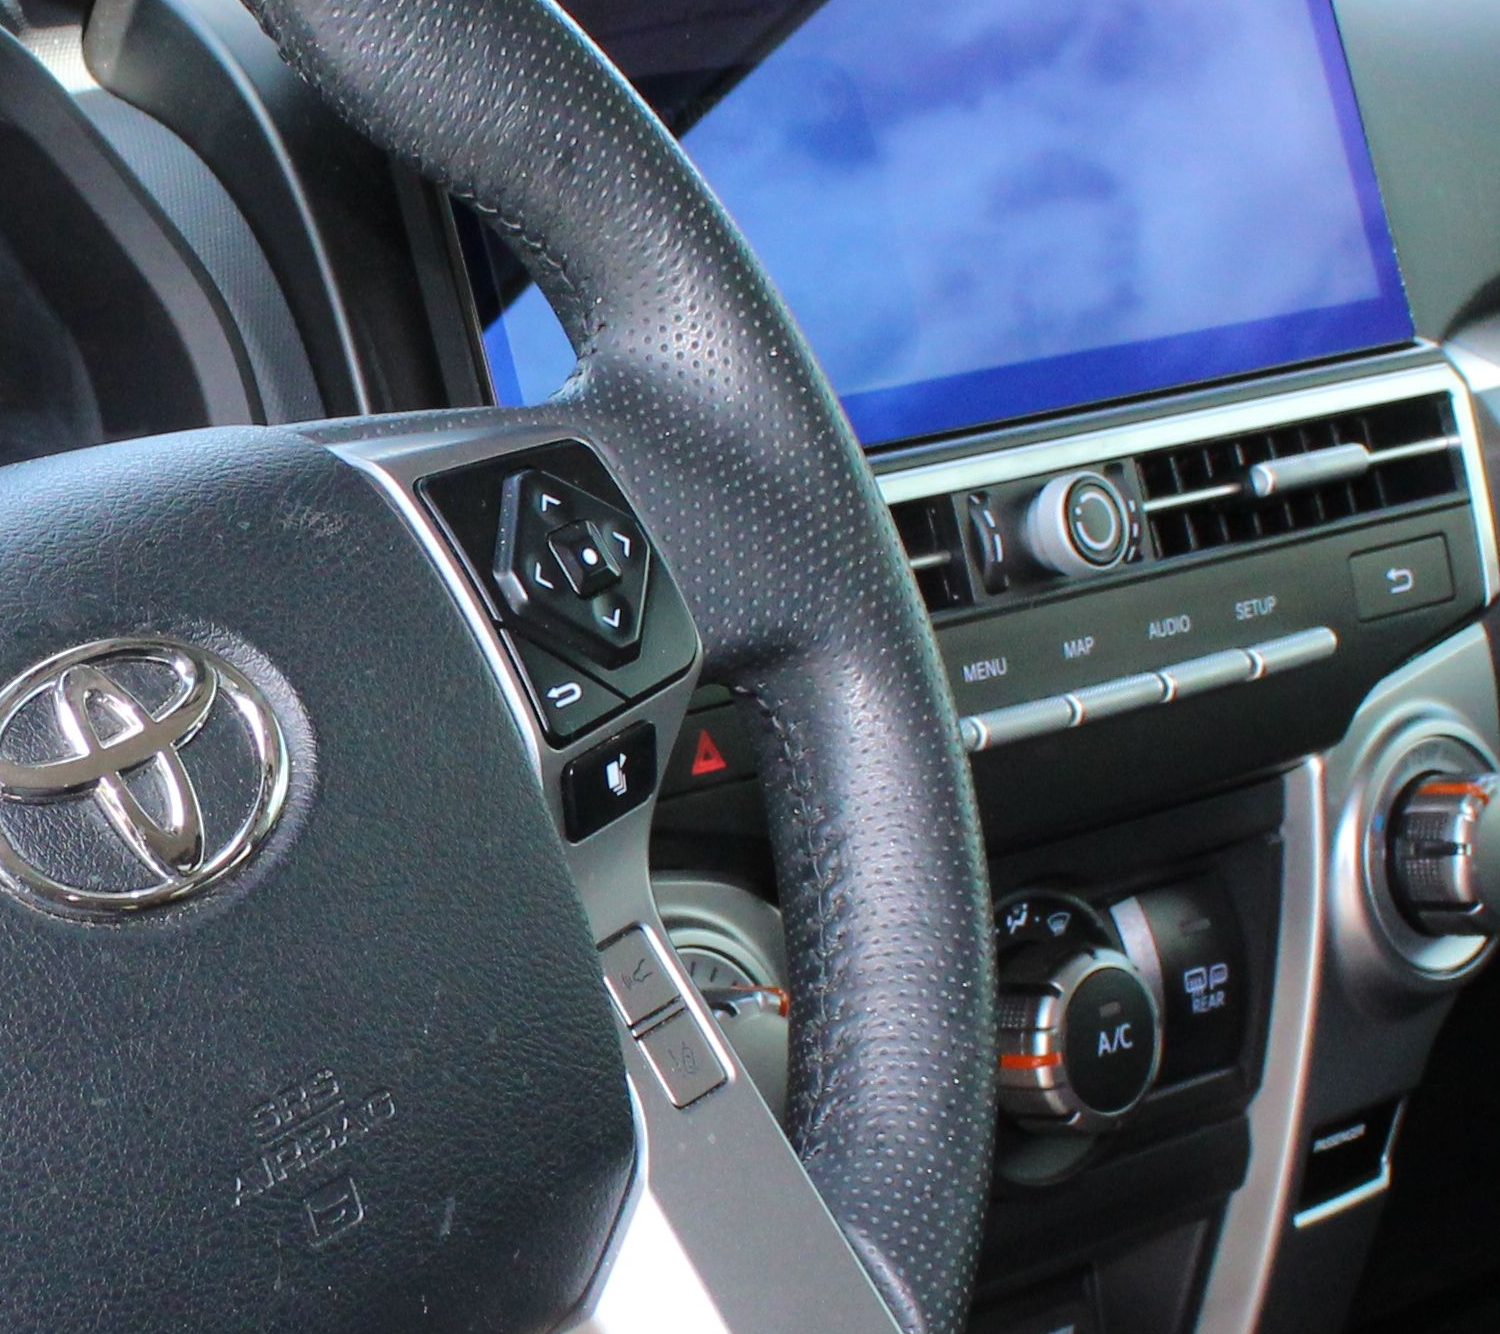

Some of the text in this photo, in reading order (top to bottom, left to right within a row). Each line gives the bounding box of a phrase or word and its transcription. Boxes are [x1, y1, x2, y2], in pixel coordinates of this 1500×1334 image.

[1235, 595, 1277, 620] SETUP
[1149, 614, 1191, 641] AUDIO
[1063, 635, 1095, 660] MAP
[963, 657, 1008, 683] MENU
[1191, 991, 1225, 1014] REAR
[1098, 1022, 1133, 1057] A/C
